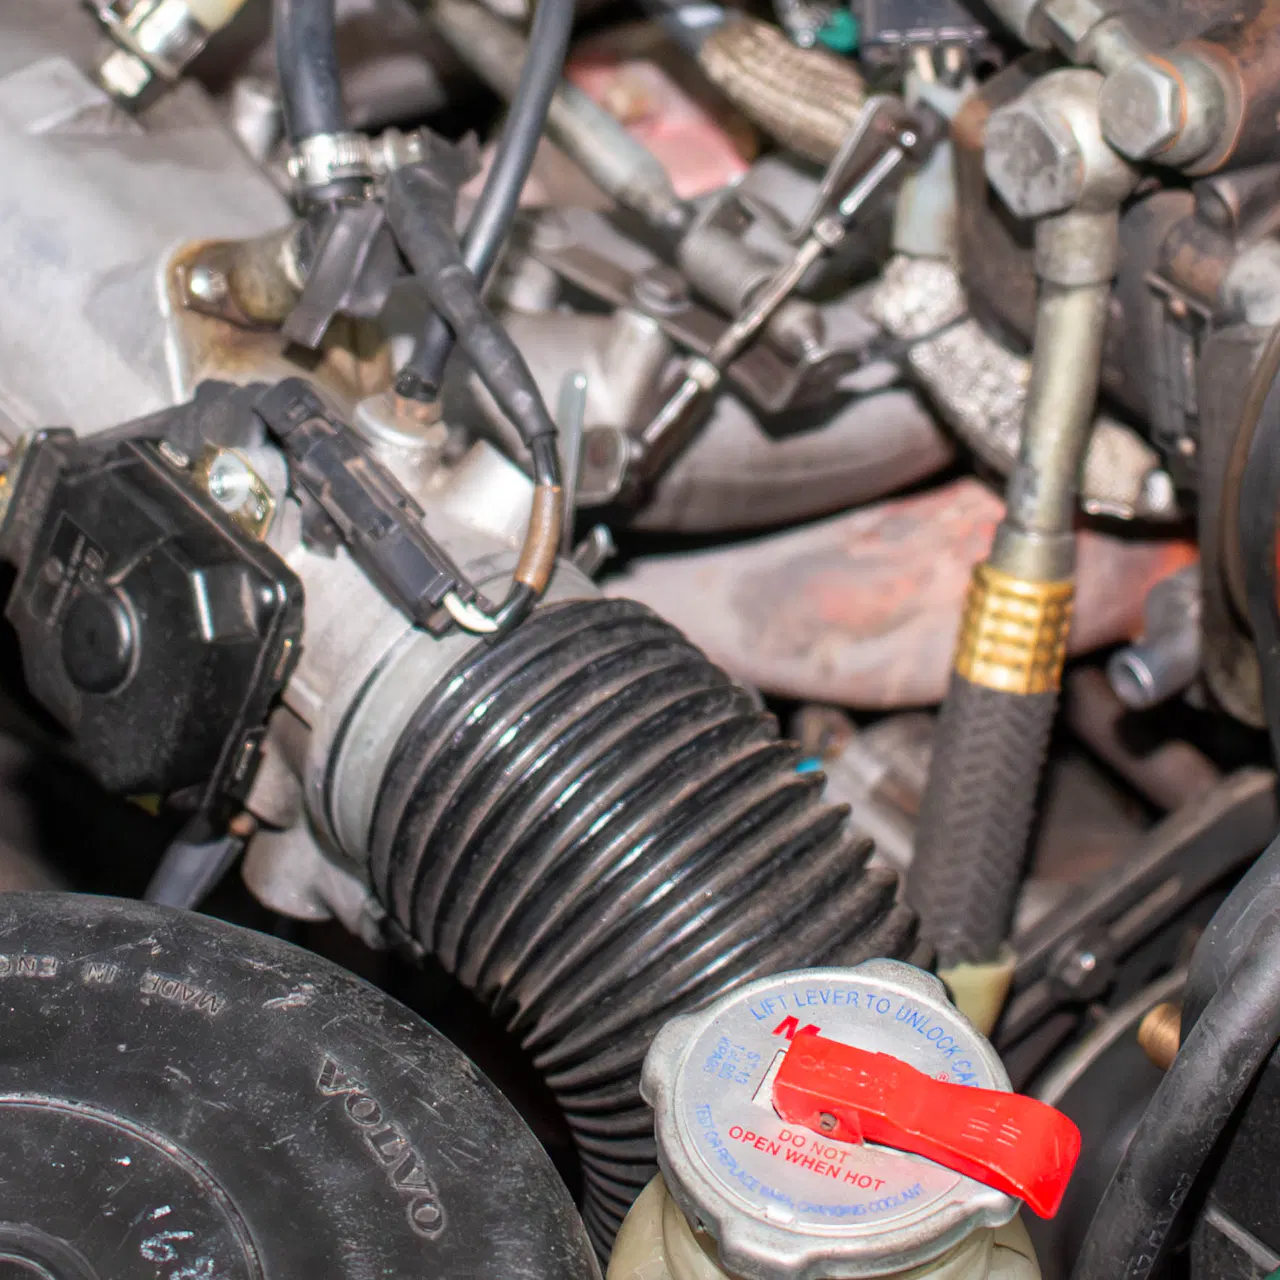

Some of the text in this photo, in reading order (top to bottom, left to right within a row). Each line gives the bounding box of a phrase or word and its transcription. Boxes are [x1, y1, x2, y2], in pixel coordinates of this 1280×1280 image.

[82, 961, 120, 984] IN
[140, 971, 227, 1016] MADE
[750, 994, 788, 1020] LIFT
[793, 989, 859, 1008] LEVER
[867, 993, 891, 1015] TO
[895, 1004, 964, 1060] UNLOCK
[316, 1052, 447, 1241] VOLVO
[728, 1125, 886, 1192] OPEN WHEN HOT
[778, 1128, 853, 1165] DO NOT
